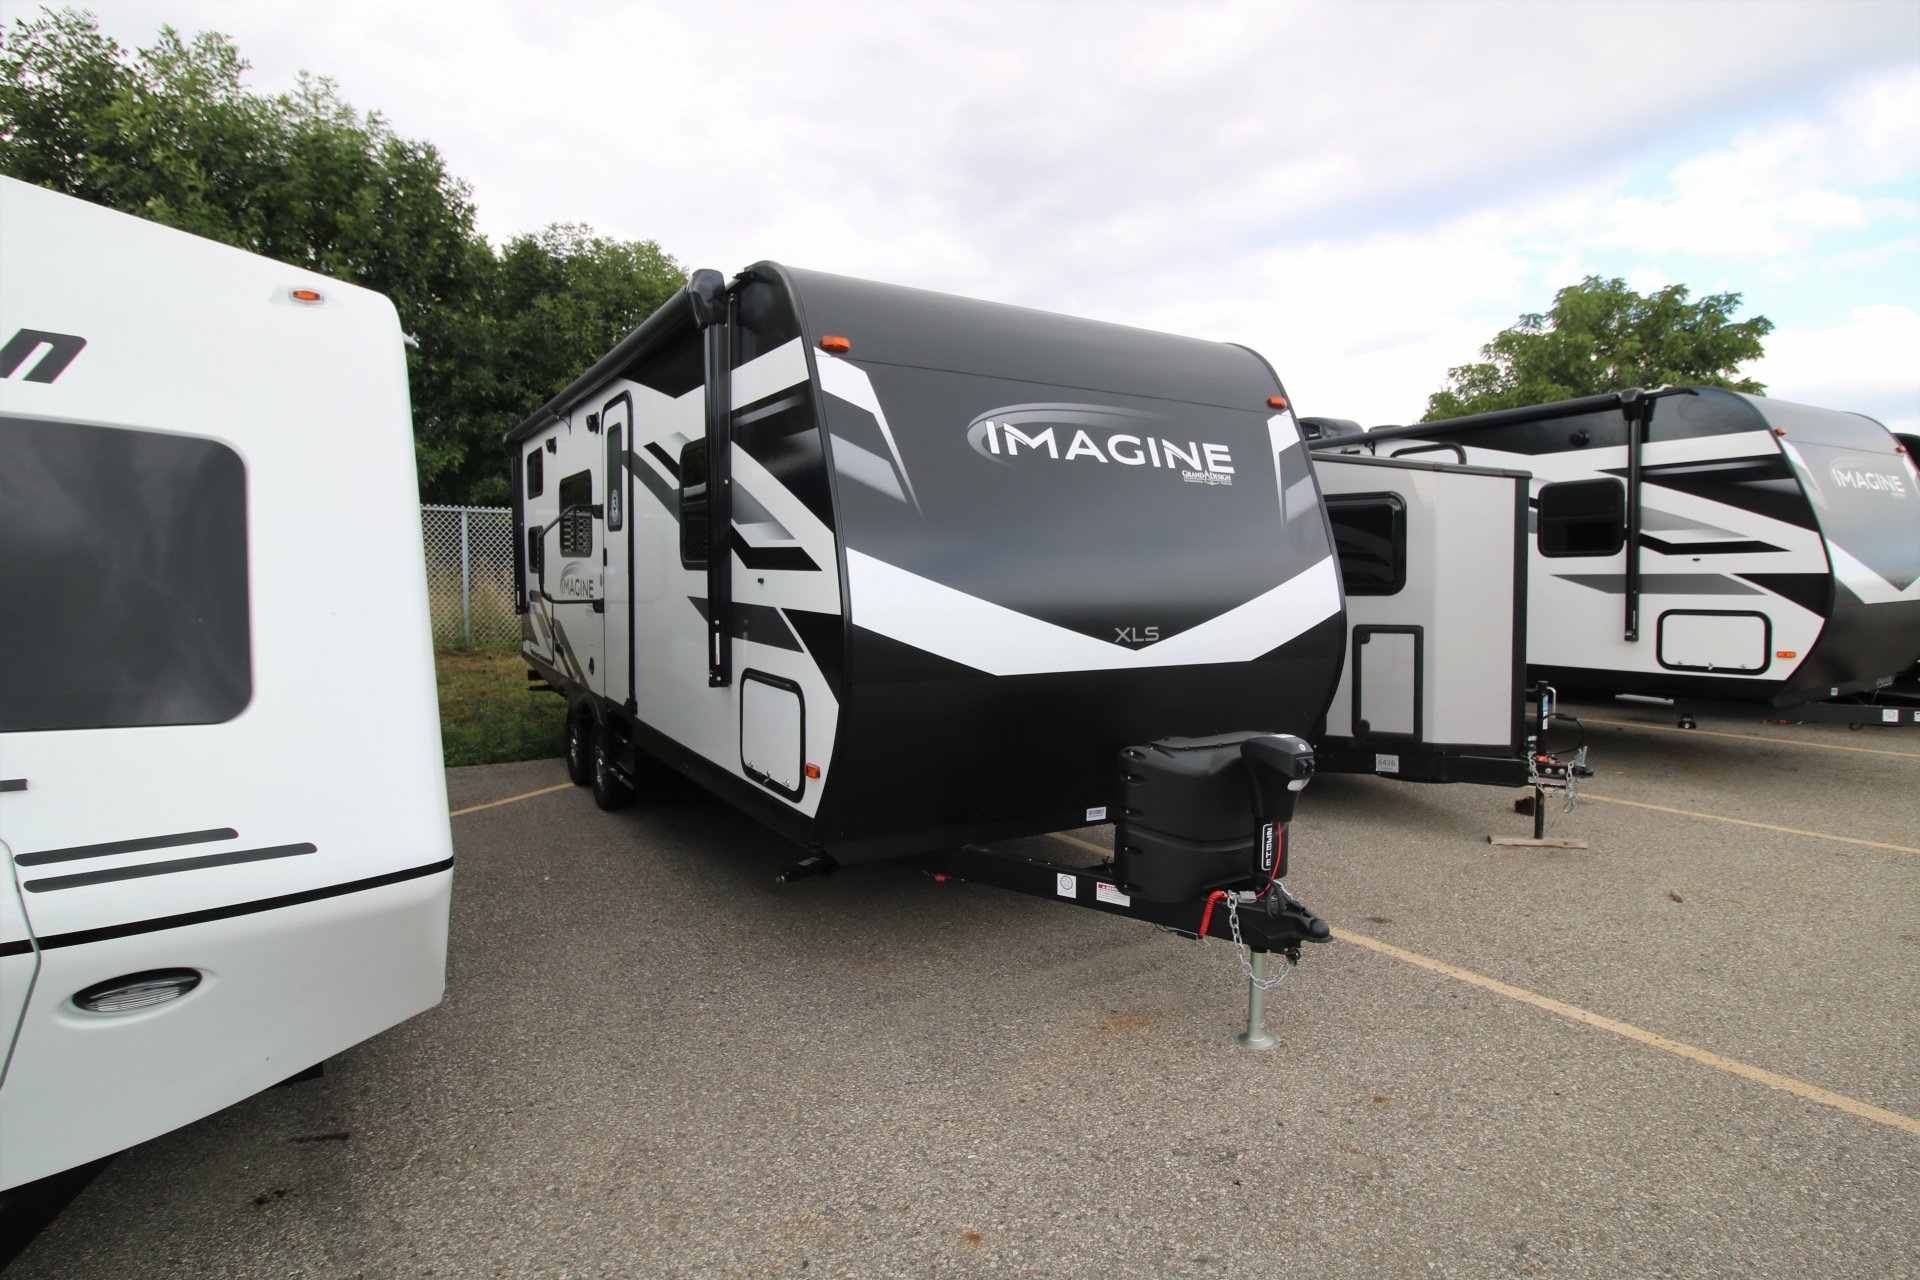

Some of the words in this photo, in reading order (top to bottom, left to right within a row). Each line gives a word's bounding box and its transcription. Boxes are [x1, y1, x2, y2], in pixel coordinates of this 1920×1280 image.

[985, 420, 1235, 474] IMAGINE
[1181, 469, 1205, 479] GRAND
[1209, 472, 1232, 481] DESIGN
[1831, 468, 1905, 493] IMAGINE
[561, 578, 594, 599] IMAGINE
[1114, 626, 1160, 643] XLS
